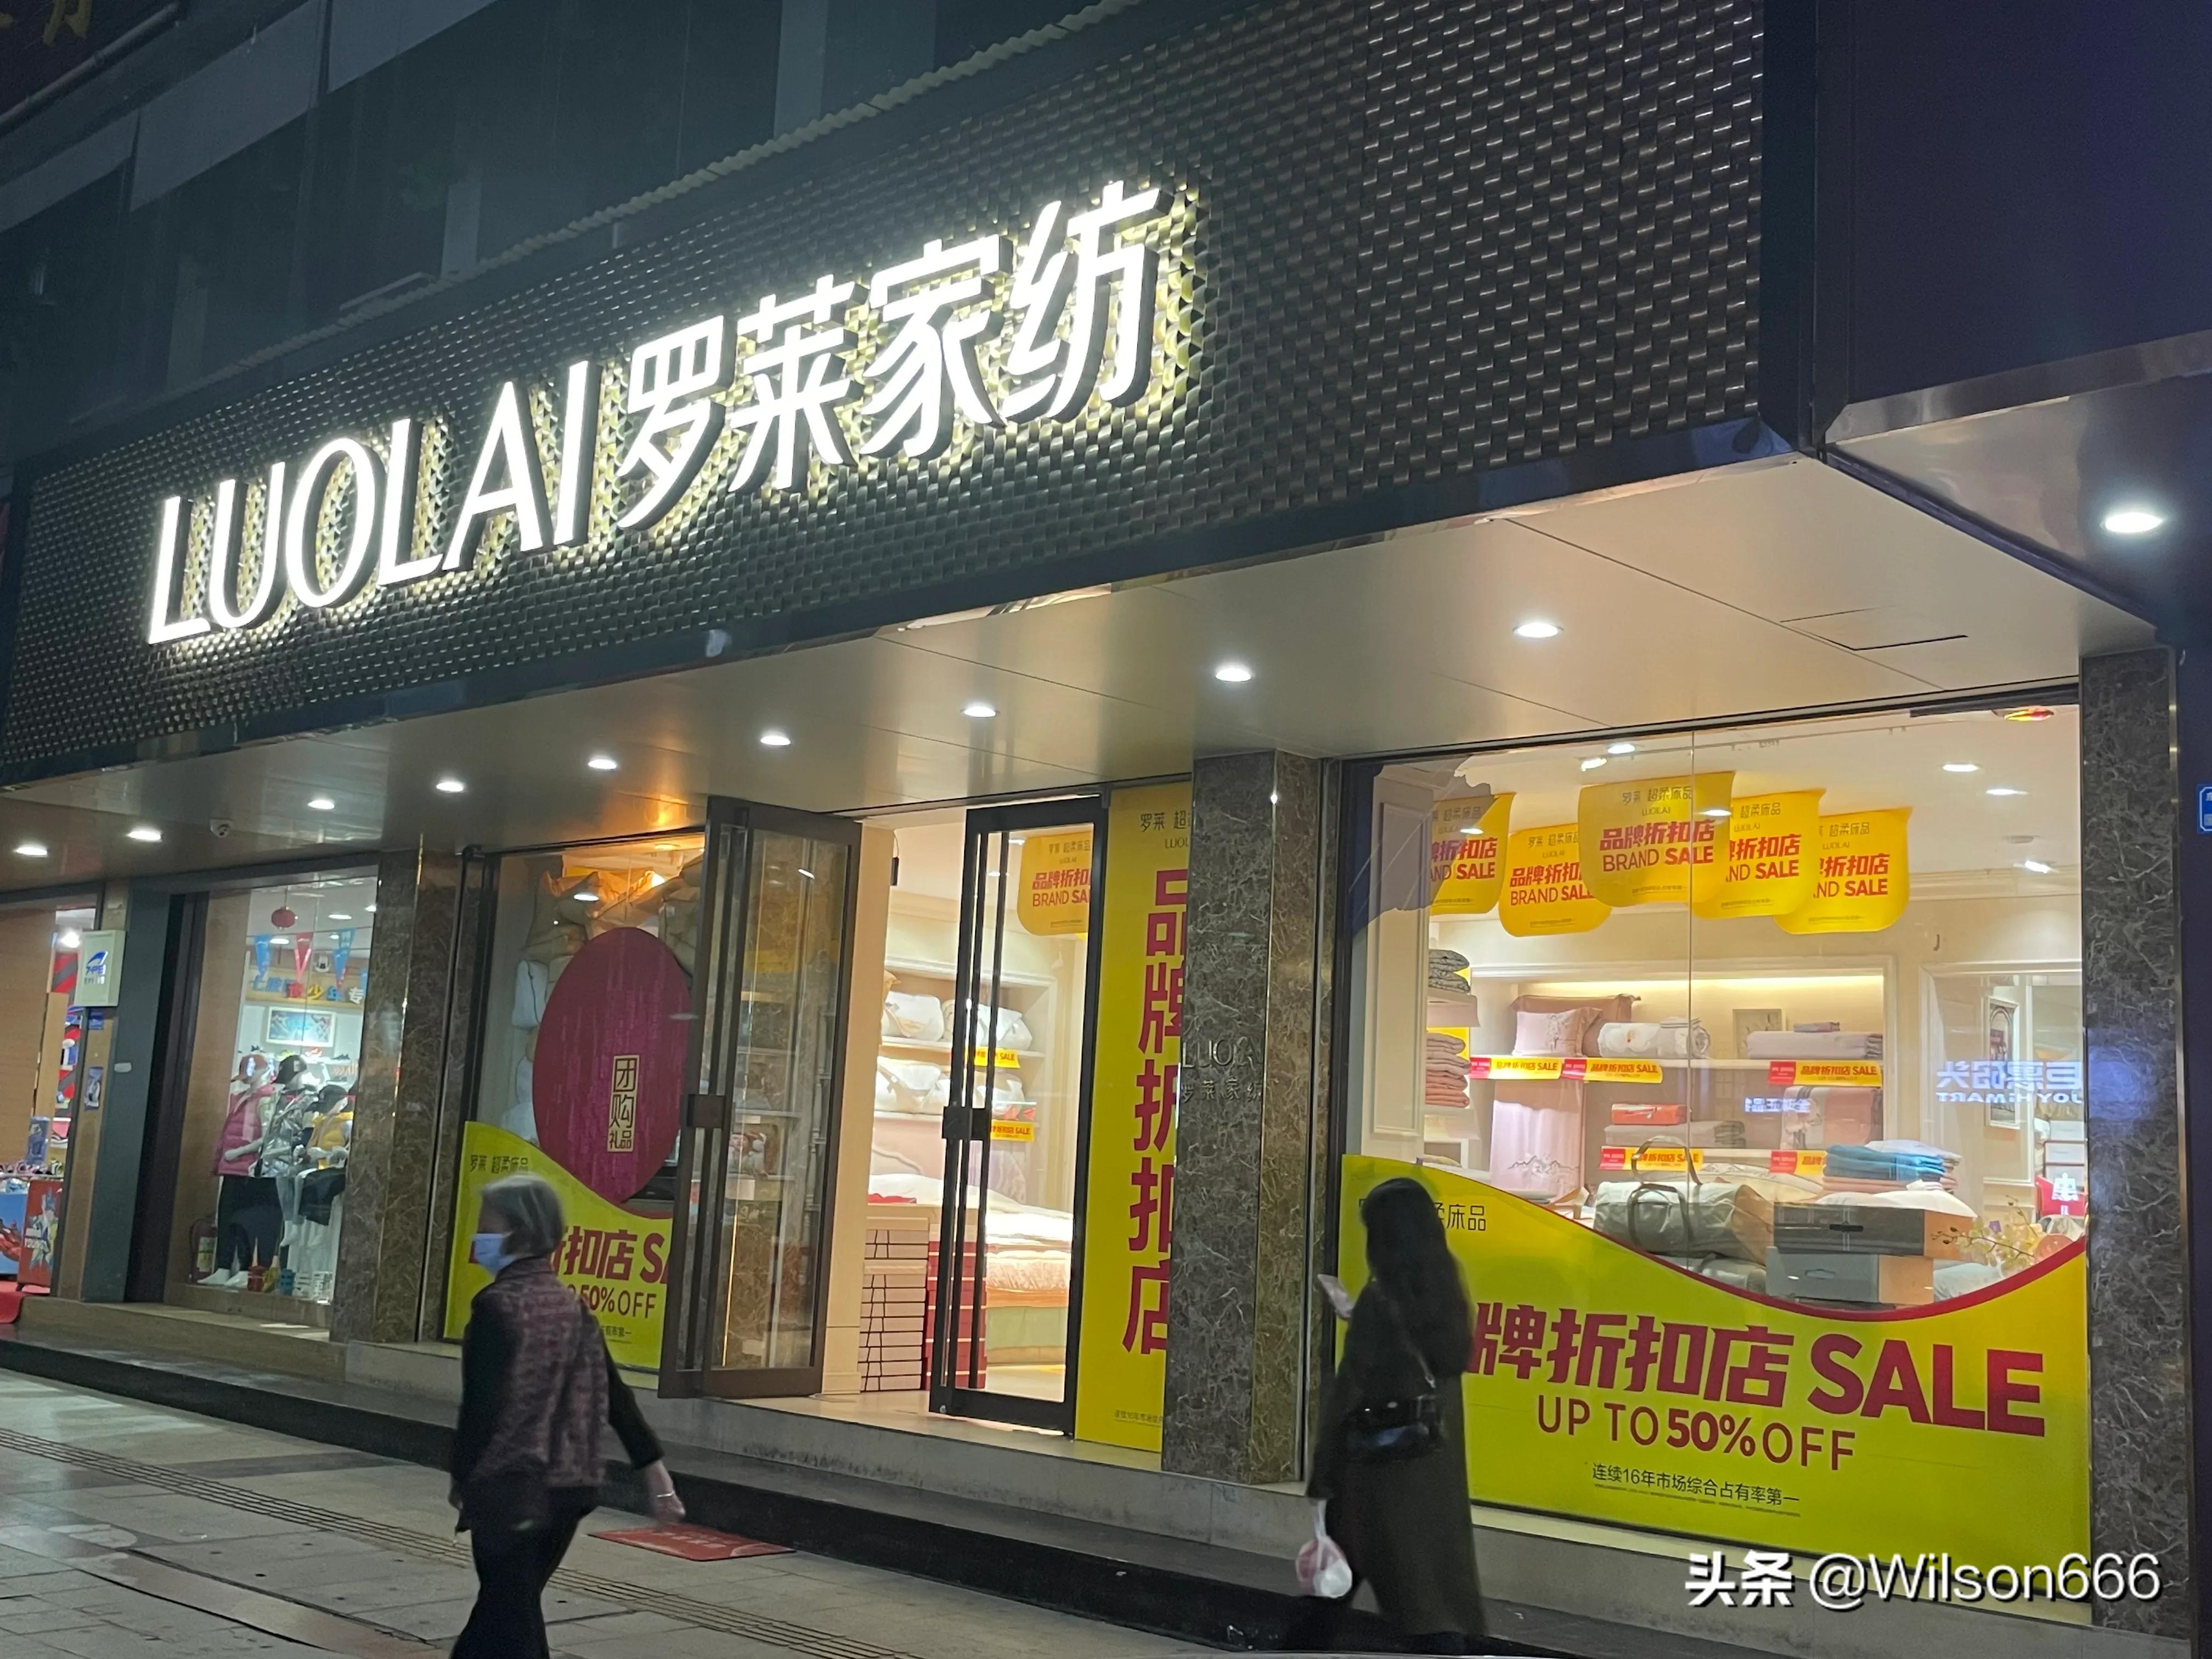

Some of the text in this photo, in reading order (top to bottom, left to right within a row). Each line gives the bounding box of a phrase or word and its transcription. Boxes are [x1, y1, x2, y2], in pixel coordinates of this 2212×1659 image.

[616, 180, 1169, 529] 罗莱家纺
[147, 360, 599, 643] LUOLAI
[1141, 810, 1191, 832] 罗莱 超
[1600, 819, 1716, 851] 品牌折扣店
[1729, 834, 1801, 861] 折扣店
[1457, 862, 1495, 880] SALE
[1602, 846, 1713, 872] BRAND SALE
[1726, 860, 1799, 882] ND SALE
[1820, 853, 1890, 878] 折扣店
[1510, 862, 1582, 887] 品牌折扣
[1032, 890, 1069, 907] BRAND
[1510, 887, 1558, 906] BRAND
[1813, 878, 1888, 898] ND SALE
[1537, 1063, 1558, 1071] SALE
[1637, 1064, 1658, 1073] SALE
[1852, 1066, 1877, 1075] SALE
[640, 1232, 669, 1284] S
[1468, 1302, 2045, 1437] 牌折扣店 SALE
[1537, 1394, 1590, 1434] UP
[1592, 1462, 1800, 1505] 连续16年市场综合占有率第一
